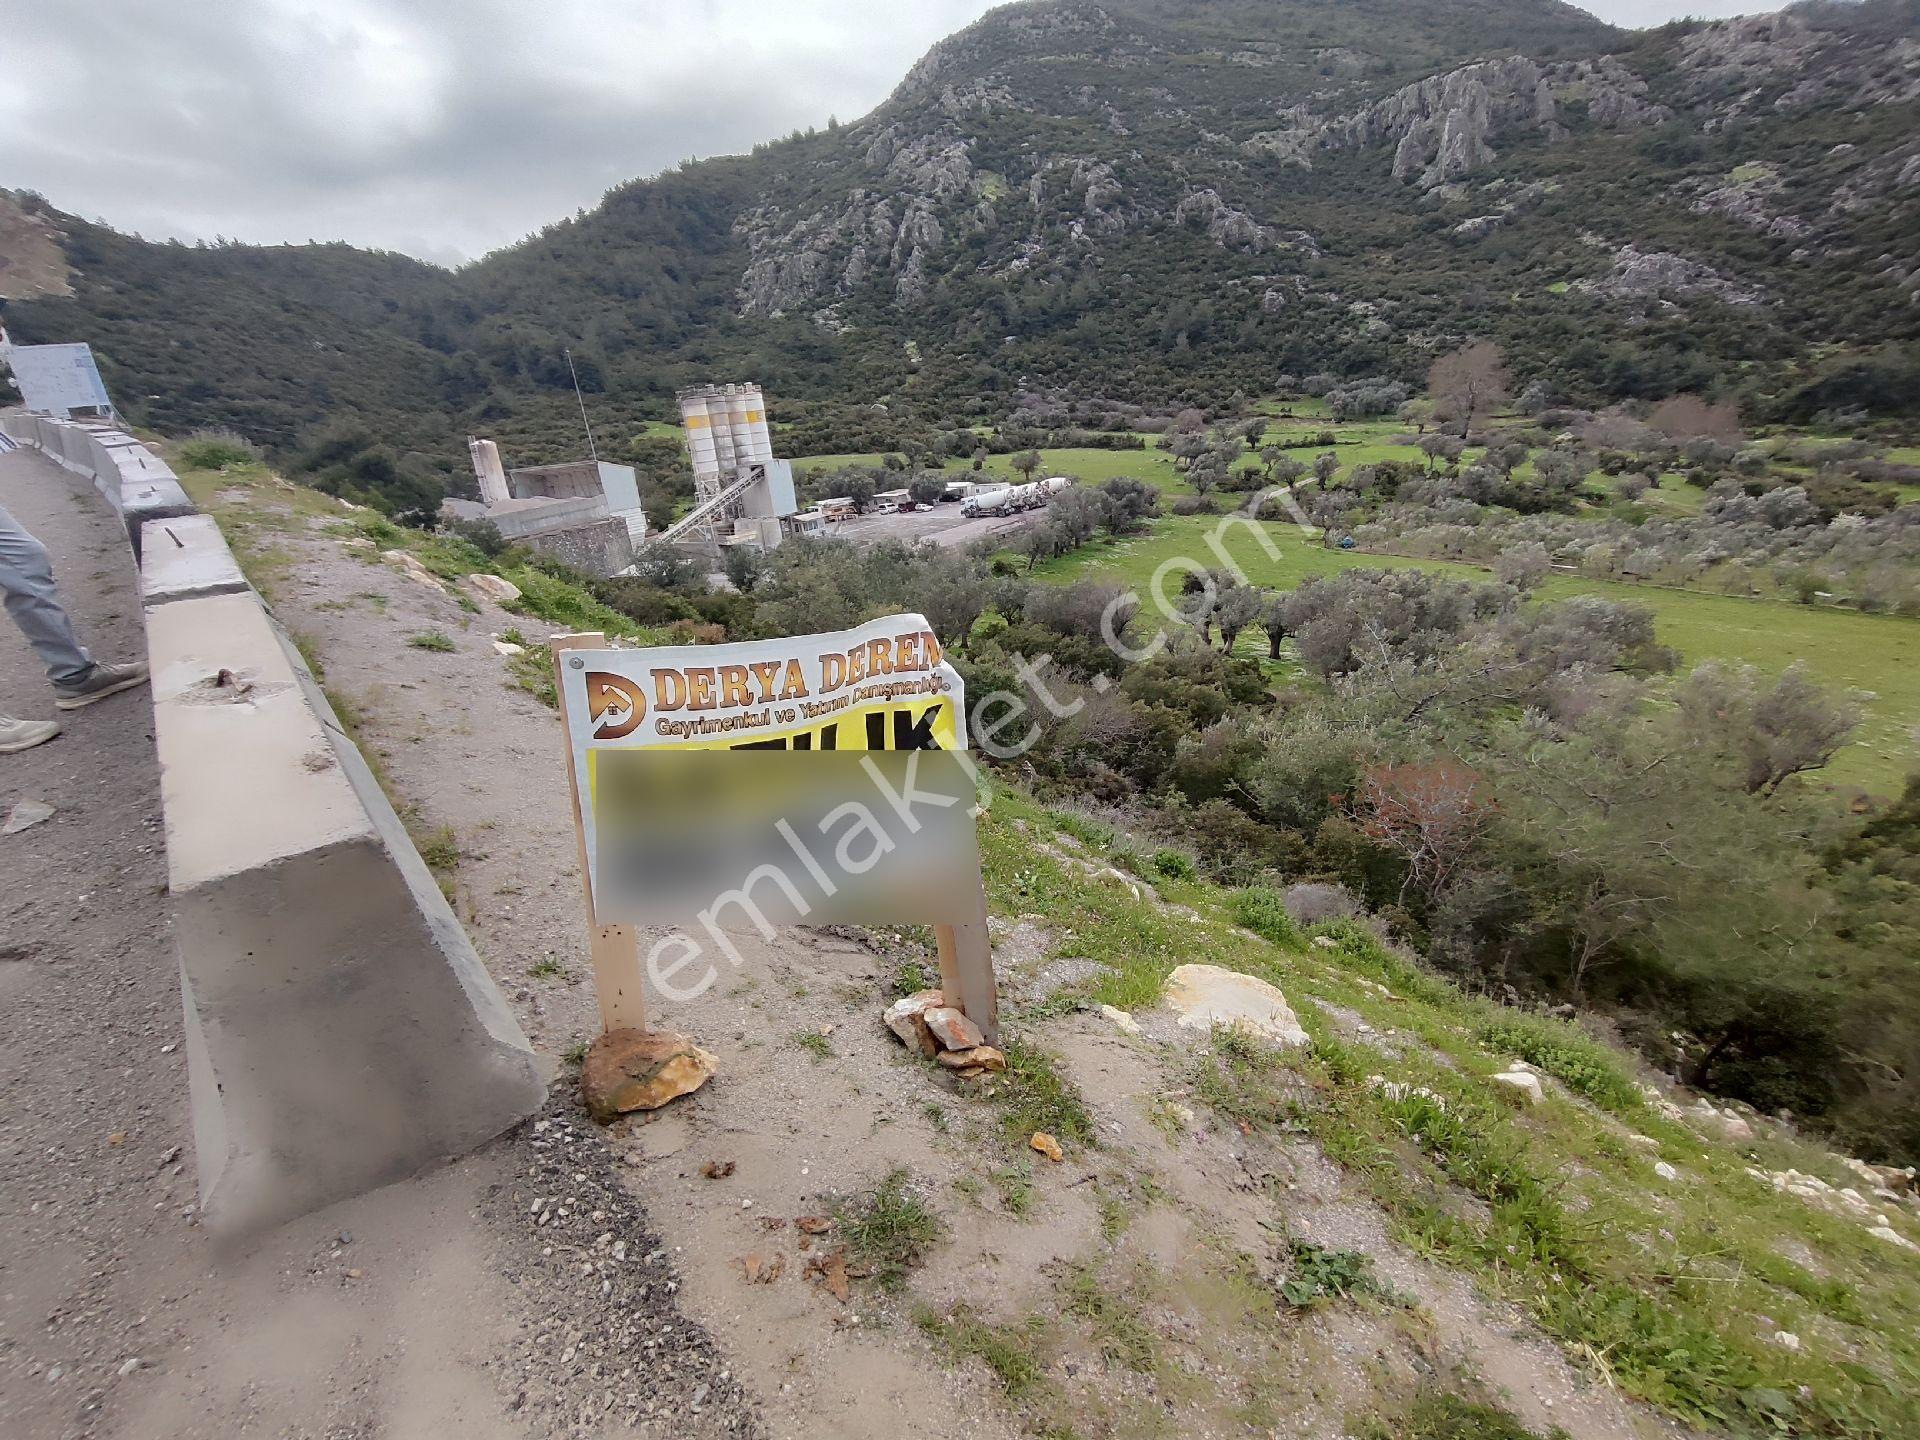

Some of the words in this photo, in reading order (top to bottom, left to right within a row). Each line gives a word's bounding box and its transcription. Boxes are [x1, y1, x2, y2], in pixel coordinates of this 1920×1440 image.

[650, 658, 809, 712] DERYA
[655, 708, 770, 739] Gayrimenkul
[775, 708, 796, 723] ve
